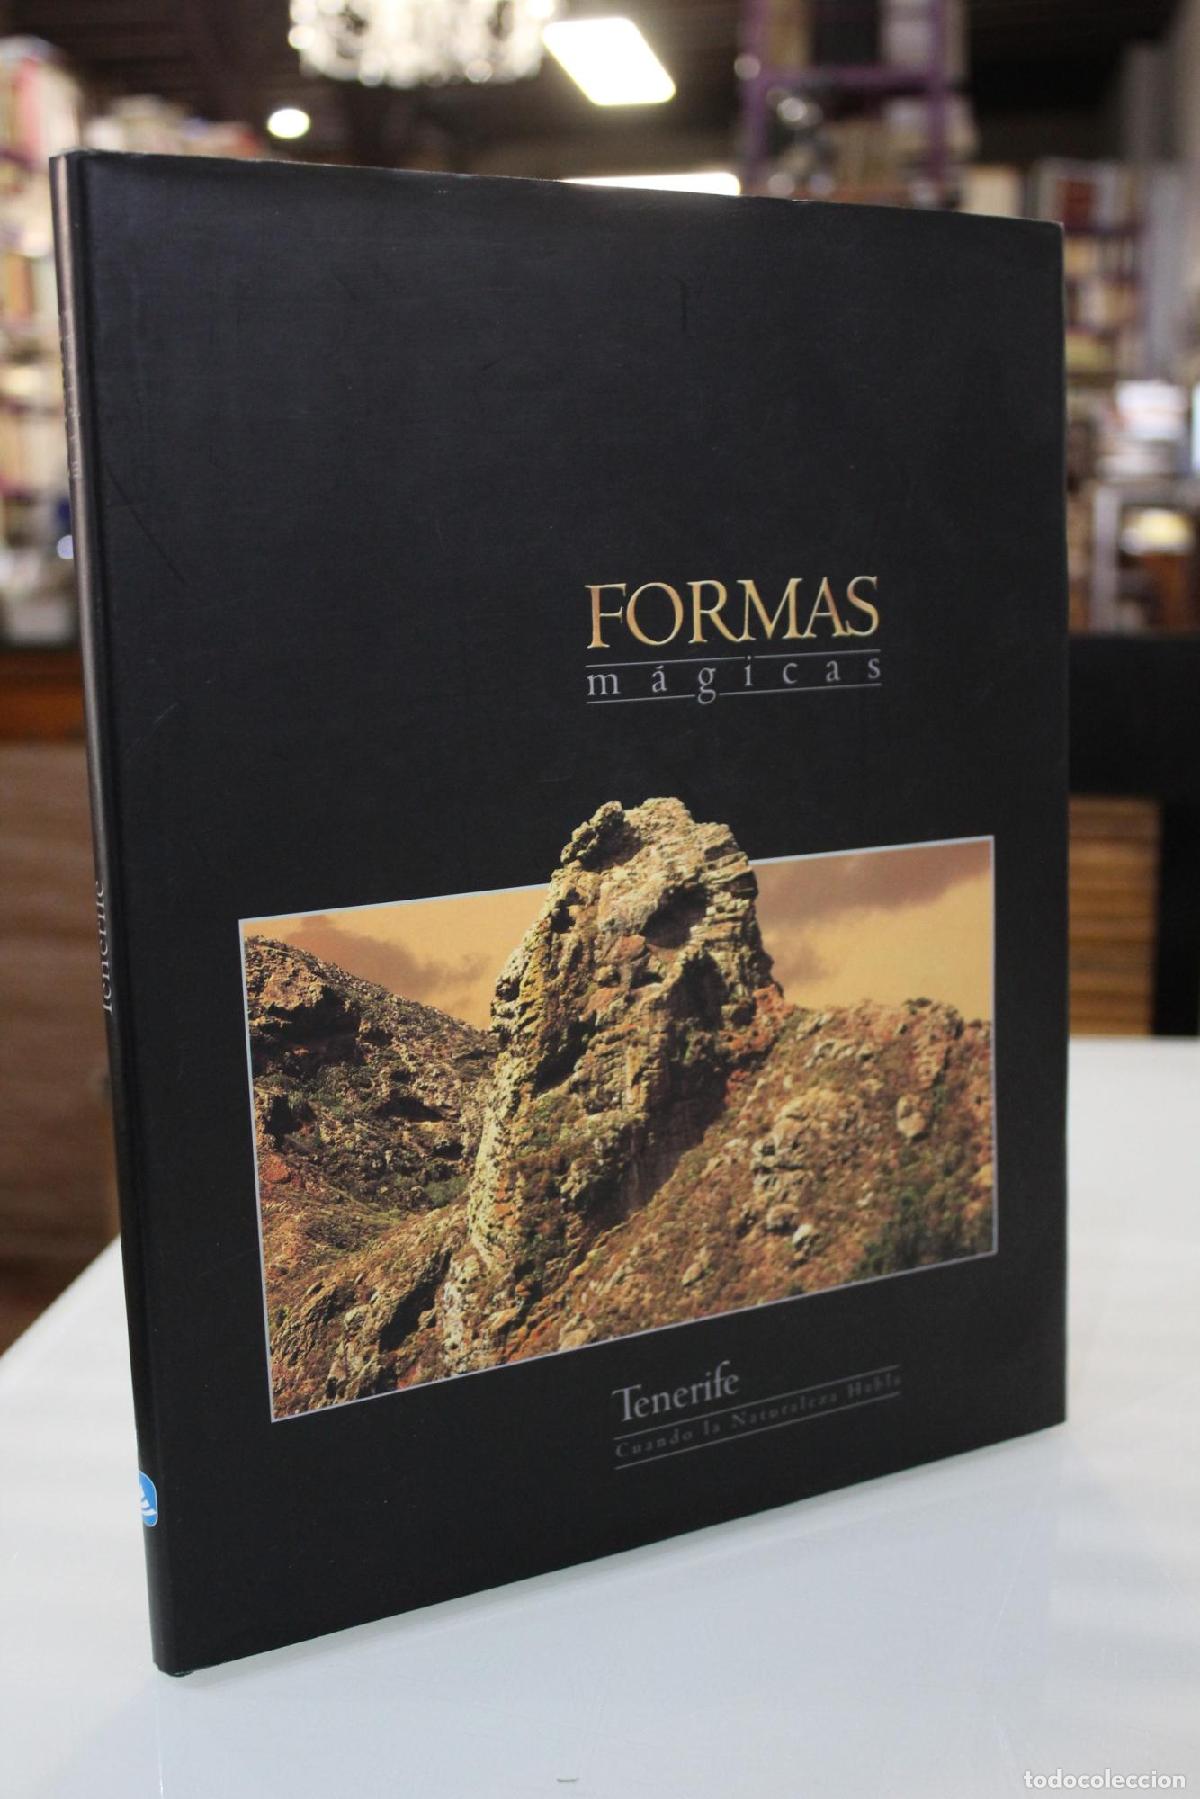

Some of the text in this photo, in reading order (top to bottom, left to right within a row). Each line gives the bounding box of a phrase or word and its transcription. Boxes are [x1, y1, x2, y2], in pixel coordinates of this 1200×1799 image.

[585, 576, 880, 649] FORMAS
[587, 655, 881, 704] mágicas
[612, 1360, 740, 1421] Tenerife
[615, 1429, 693, 1458] Cuando
[703, 1419, 721, 1436] la
[731, 1394, 838, 1429] Naturaleza
